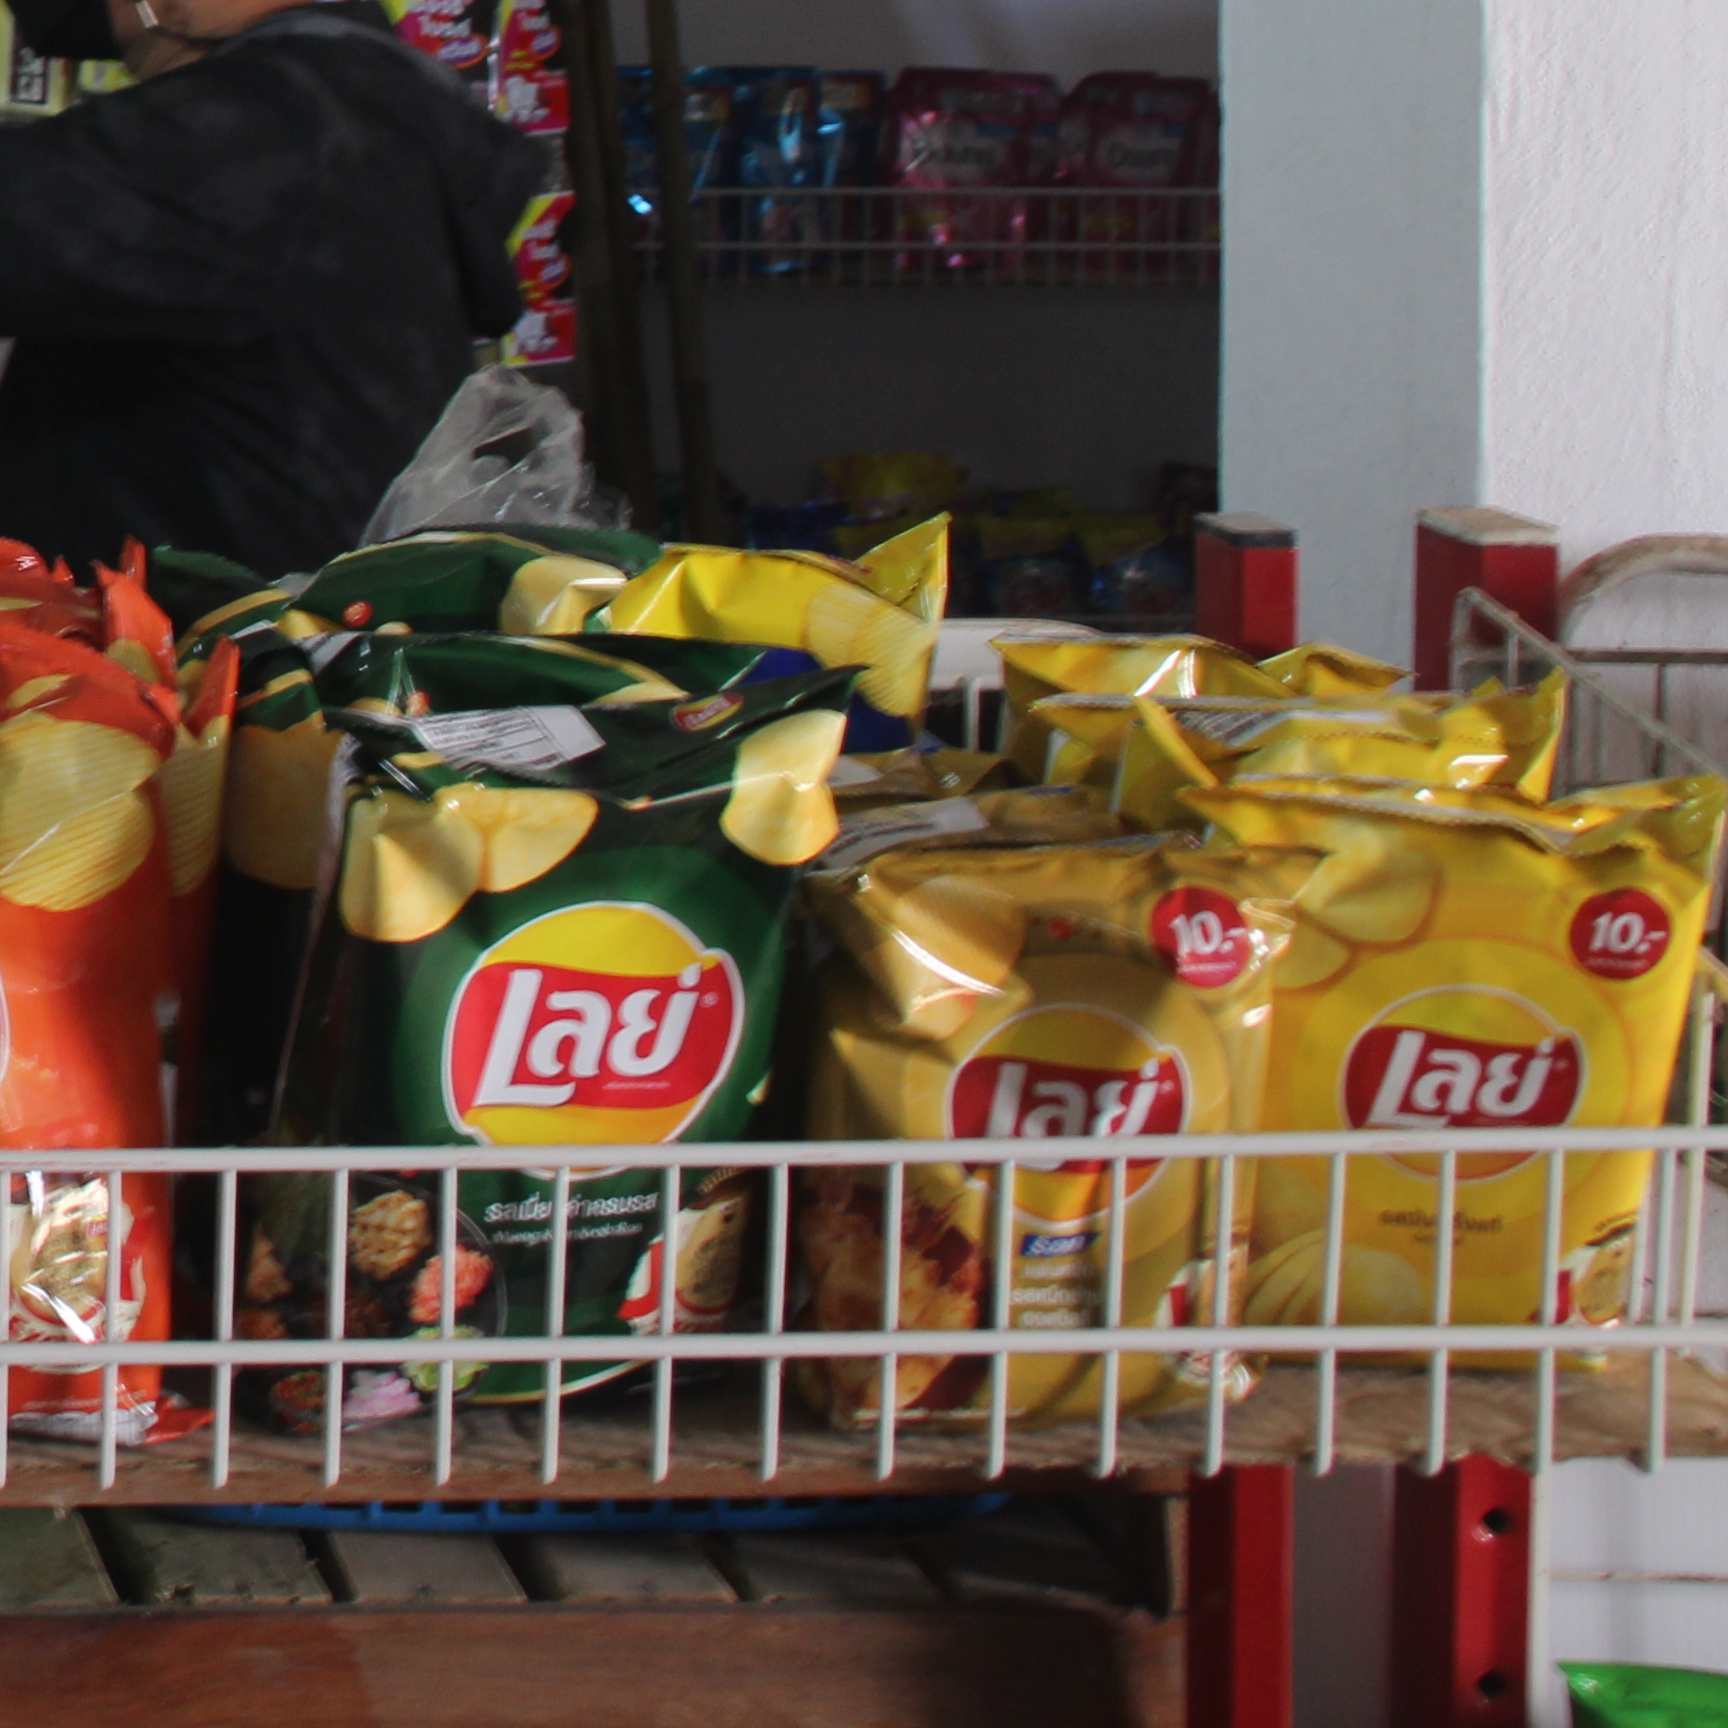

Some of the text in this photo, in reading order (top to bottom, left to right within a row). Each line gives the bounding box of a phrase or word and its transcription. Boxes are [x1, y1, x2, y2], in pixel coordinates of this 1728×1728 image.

[483, 1191, 662, 1223] รสเมี่ยคำครบรส
